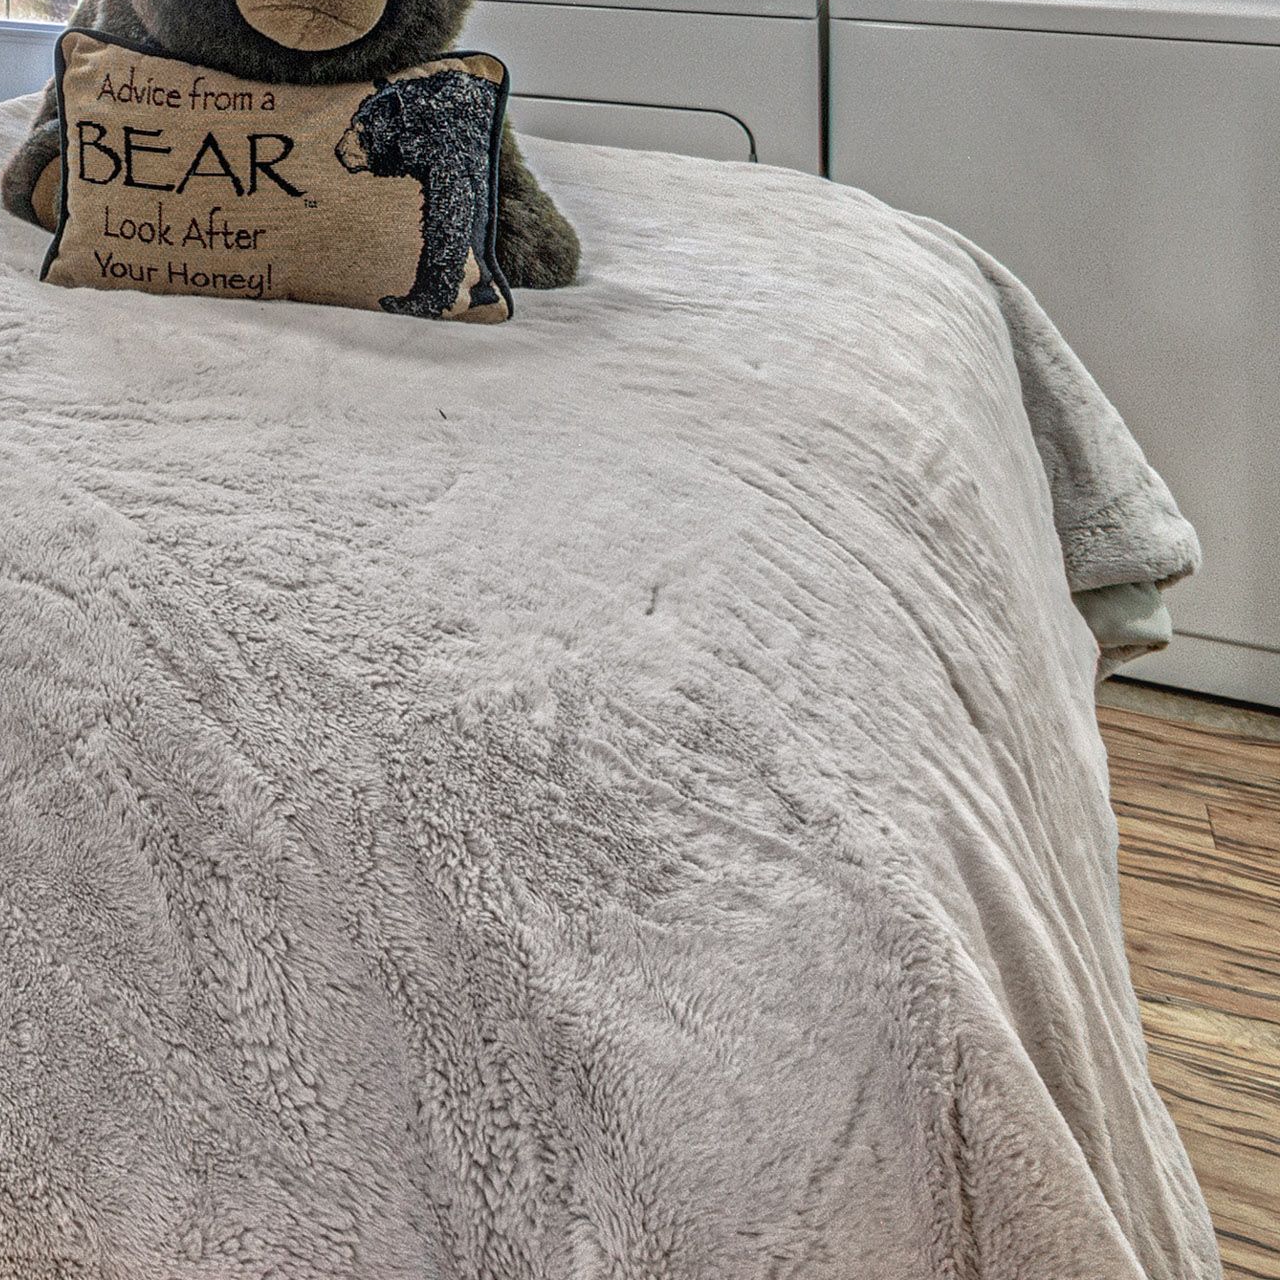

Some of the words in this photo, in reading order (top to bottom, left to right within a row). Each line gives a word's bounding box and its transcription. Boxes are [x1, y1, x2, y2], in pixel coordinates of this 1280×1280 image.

[96, 66, 181, 108] Advice
[188, 77, 253, 111] from
[260, 92, 275, 111] a
[76, 120, 308, 197] BEAR
[103, 202, 174, 246] Look
[182, 206, 266, 250] After
[94, 250, 158, 283] Your
[168, 262, 272, 299] Honey!
